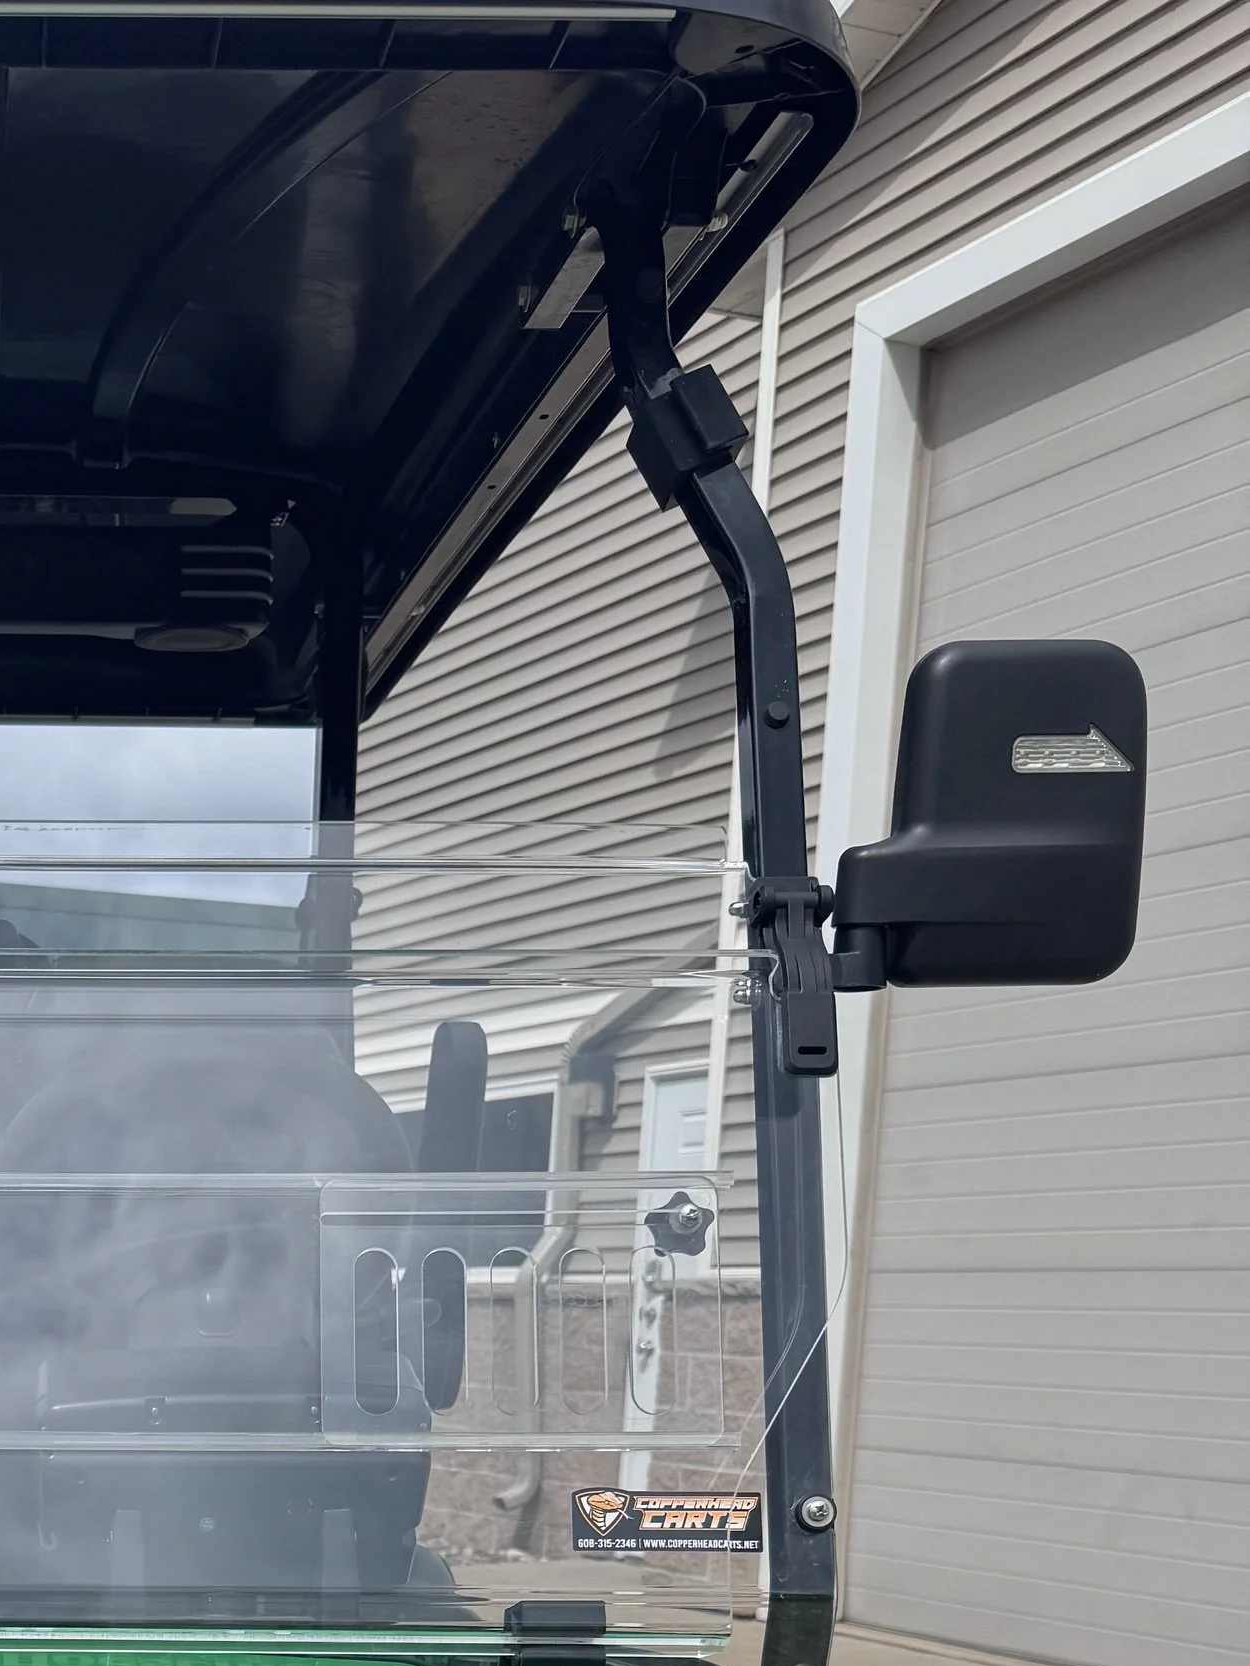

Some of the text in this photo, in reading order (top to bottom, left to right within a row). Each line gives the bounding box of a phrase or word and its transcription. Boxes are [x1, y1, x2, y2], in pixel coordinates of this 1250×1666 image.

[635, 1497, 758, 1510] COPPERHEAD
[641, 1511, 750, 1529] CARTS
[578, 1538, 760, 1549] 608-315-2346 WWW.COPPERHEADCARTS.NET
